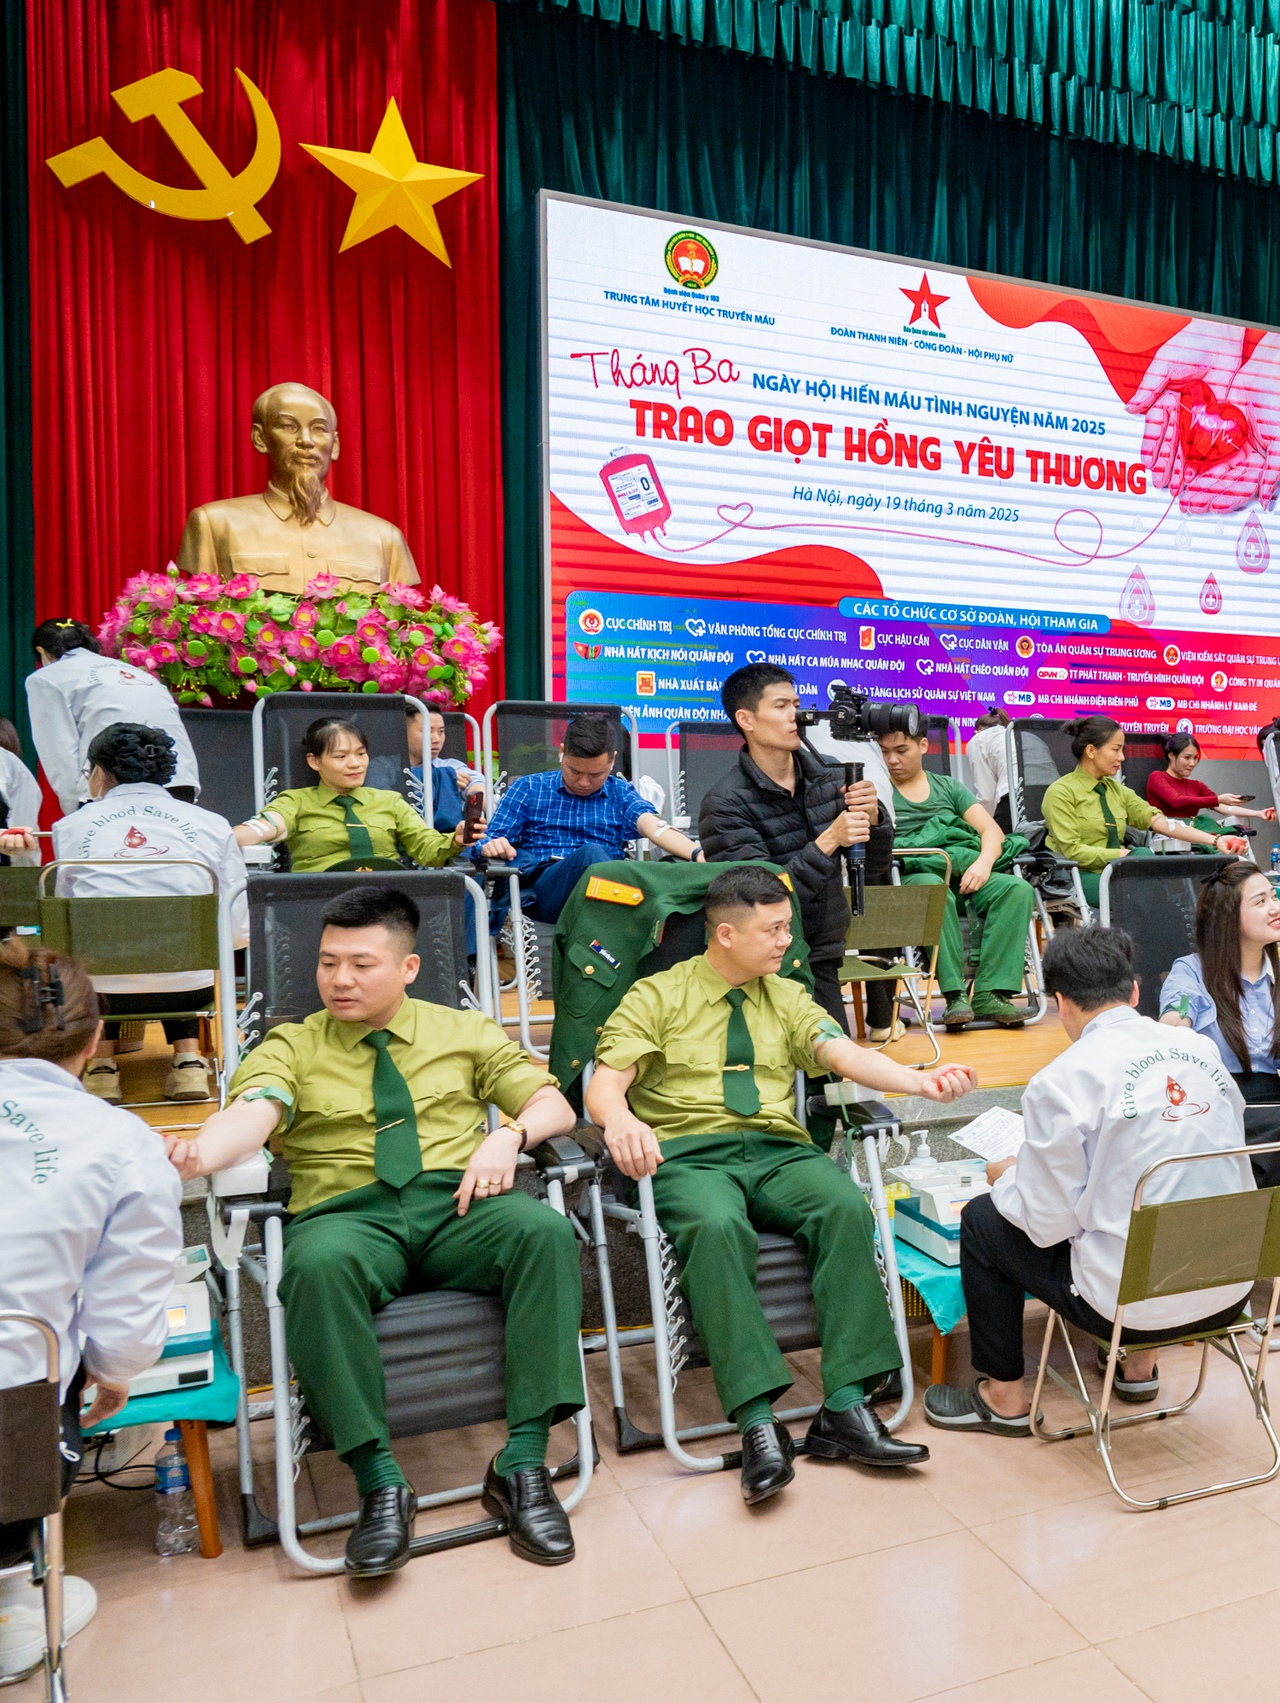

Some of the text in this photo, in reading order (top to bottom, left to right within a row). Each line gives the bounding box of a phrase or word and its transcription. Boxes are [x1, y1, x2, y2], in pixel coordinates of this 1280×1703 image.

[604, 290, 775, 326] TRUNG TÂM HUYẾT HỌC TRUYỀN MÁU
[831, 327, 1014, 363] ĐOÀN THANH NIÊN CÔNG ĐOÀN HỘI PHỤ NỮ
[570, 348, 740, 400] Tháng Ba
[753, 373, 1106, 435] NGÀY HỘI HIẾN MÁU TÌNH NGUYỆN NĂM 2025
[630, 399, 1148, 494] TRAO GIỌT HỒNG YÊU THƯƠNG
[793, 486, 1020, 522] Hà Nội, ngày 19 tháng 3 năm 2025
[606, 618, 672, 634] CỤC CHÍNH TRỊ
[854, 602, 1098, 630] CÁC TỔ CHỨC CƠ SỞ ĐOÀN, HỘI THAM GIA
[708, 622, 846, 644] VĂN PHÒNG TỔNG CỤC CHÍNH TRỊ
[878, 634, 894, 646] CỤC
[895, 634, 912, 647] HẬU
[604, 645, 734, 665] NHÀ HÁT KỊCH NÓI QUÂN ĐỘI
[959, 638, 1008, 652] CỤC DÂN VẬN
[1036, 642, 1156, 658] TÒA ÁN QUÂN SỰ TRUNG ƯƠNG
[768, 654, 904, 672] NHÀ HÁT CA MÚA NHẠC QUÂN ĐỘI
[936, 662, 952, 673] NHÀ
[954, 662, 970, 674] HÁT
[992, 665, 1014, 676] QUÂN
[1015, 666, 1028, 678] ĐỘI
[658, 678, 704, 690] NHÀ XUẤT
[1070, 670, 1078, 678] TT
[1079, 669, 1097, 679] PHÁT
[1098, 671, 1122, 681] THANH
[1172, 674, 1191, 684] QUÂN
[1192, 674, 1204, 686] ĐỘI
[870, 686, 892, 697] TÀNG
[893, 688, 911, 700] LỊCH
[924, 688, 947, 700] QUÂN
[961, 690, 976, 702] VIỆT
[978, 692, 995, 701] NAM
[1018, 694, 1031, 702] MB
[92, 805, 200, 844] blood Save life
[1122, 1048, 1231, 1120] Give blood Save life
[0, 1100, 58, 1184] Save life
